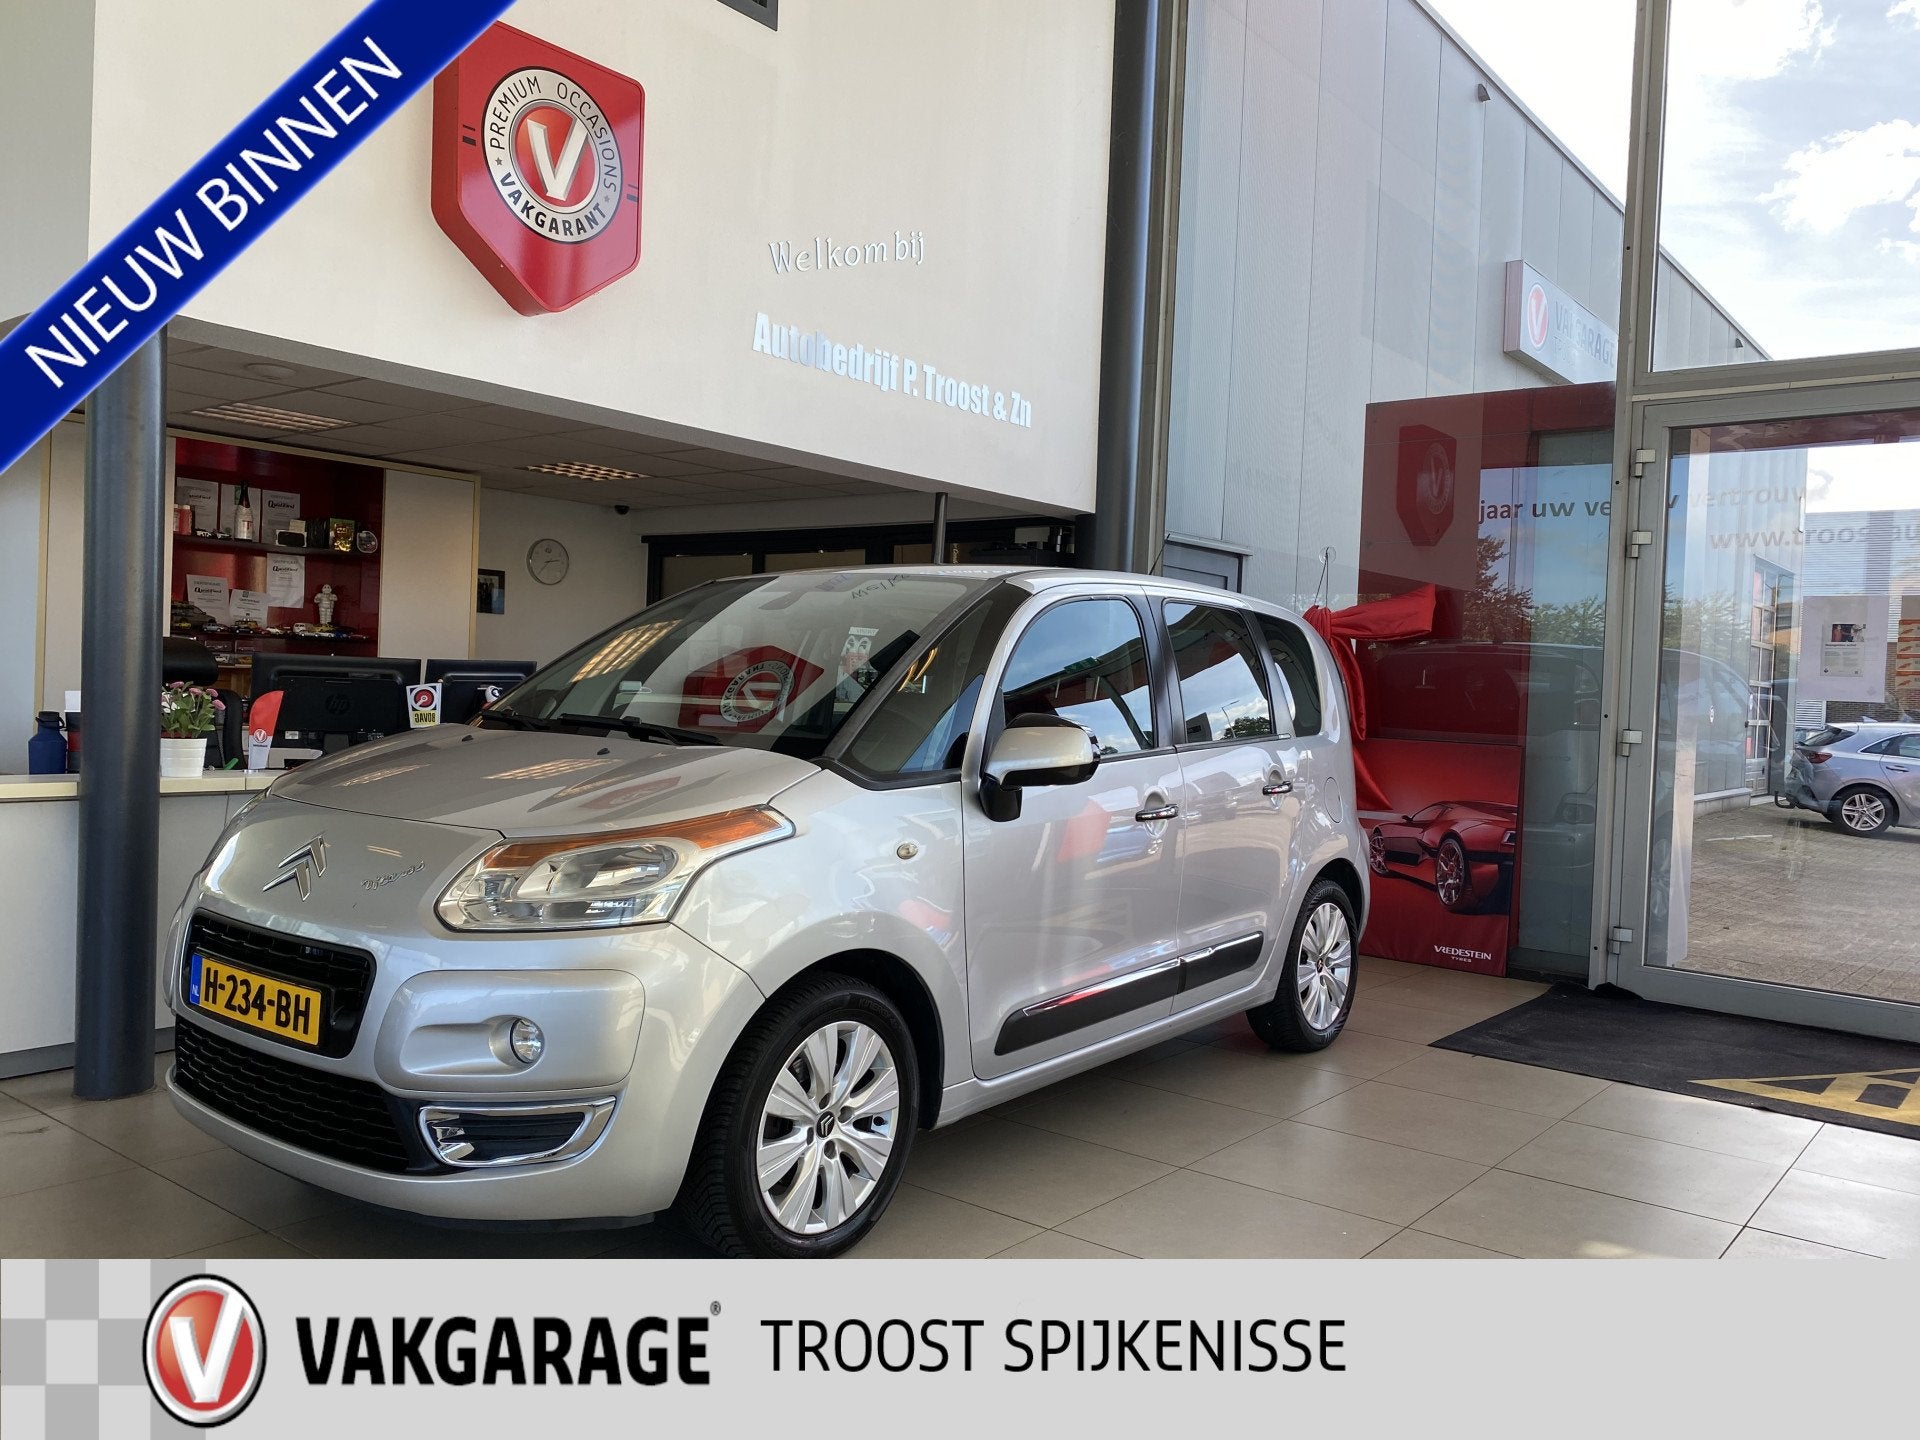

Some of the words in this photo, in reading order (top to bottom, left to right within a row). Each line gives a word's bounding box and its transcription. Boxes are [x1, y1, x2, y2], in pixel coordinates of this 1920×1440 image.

[489, 75, 542, 150] PREMIUM
[556, 82, 618, 193] OCCASIONS
[500, 171, 606, 236] VAKGARANT
[768, 237, 888, 274] Welkom
[894, 230, 925, 266] bij
[752, 311, 900, 392] Autobedrijf
[903, 358, 919, 397] P.
[922, 364, 990, 417] Troost
[993, 391, 1008, 421] &
[1009, 391, 1032, 428] Zn
[1478, 500, 1524, 524] jaar
[1532, 502, 1576, 518] uw
[1434, 945, 1492, 960] VREDESTEIN
[204, 967, 311, 1035] H-234-BH
